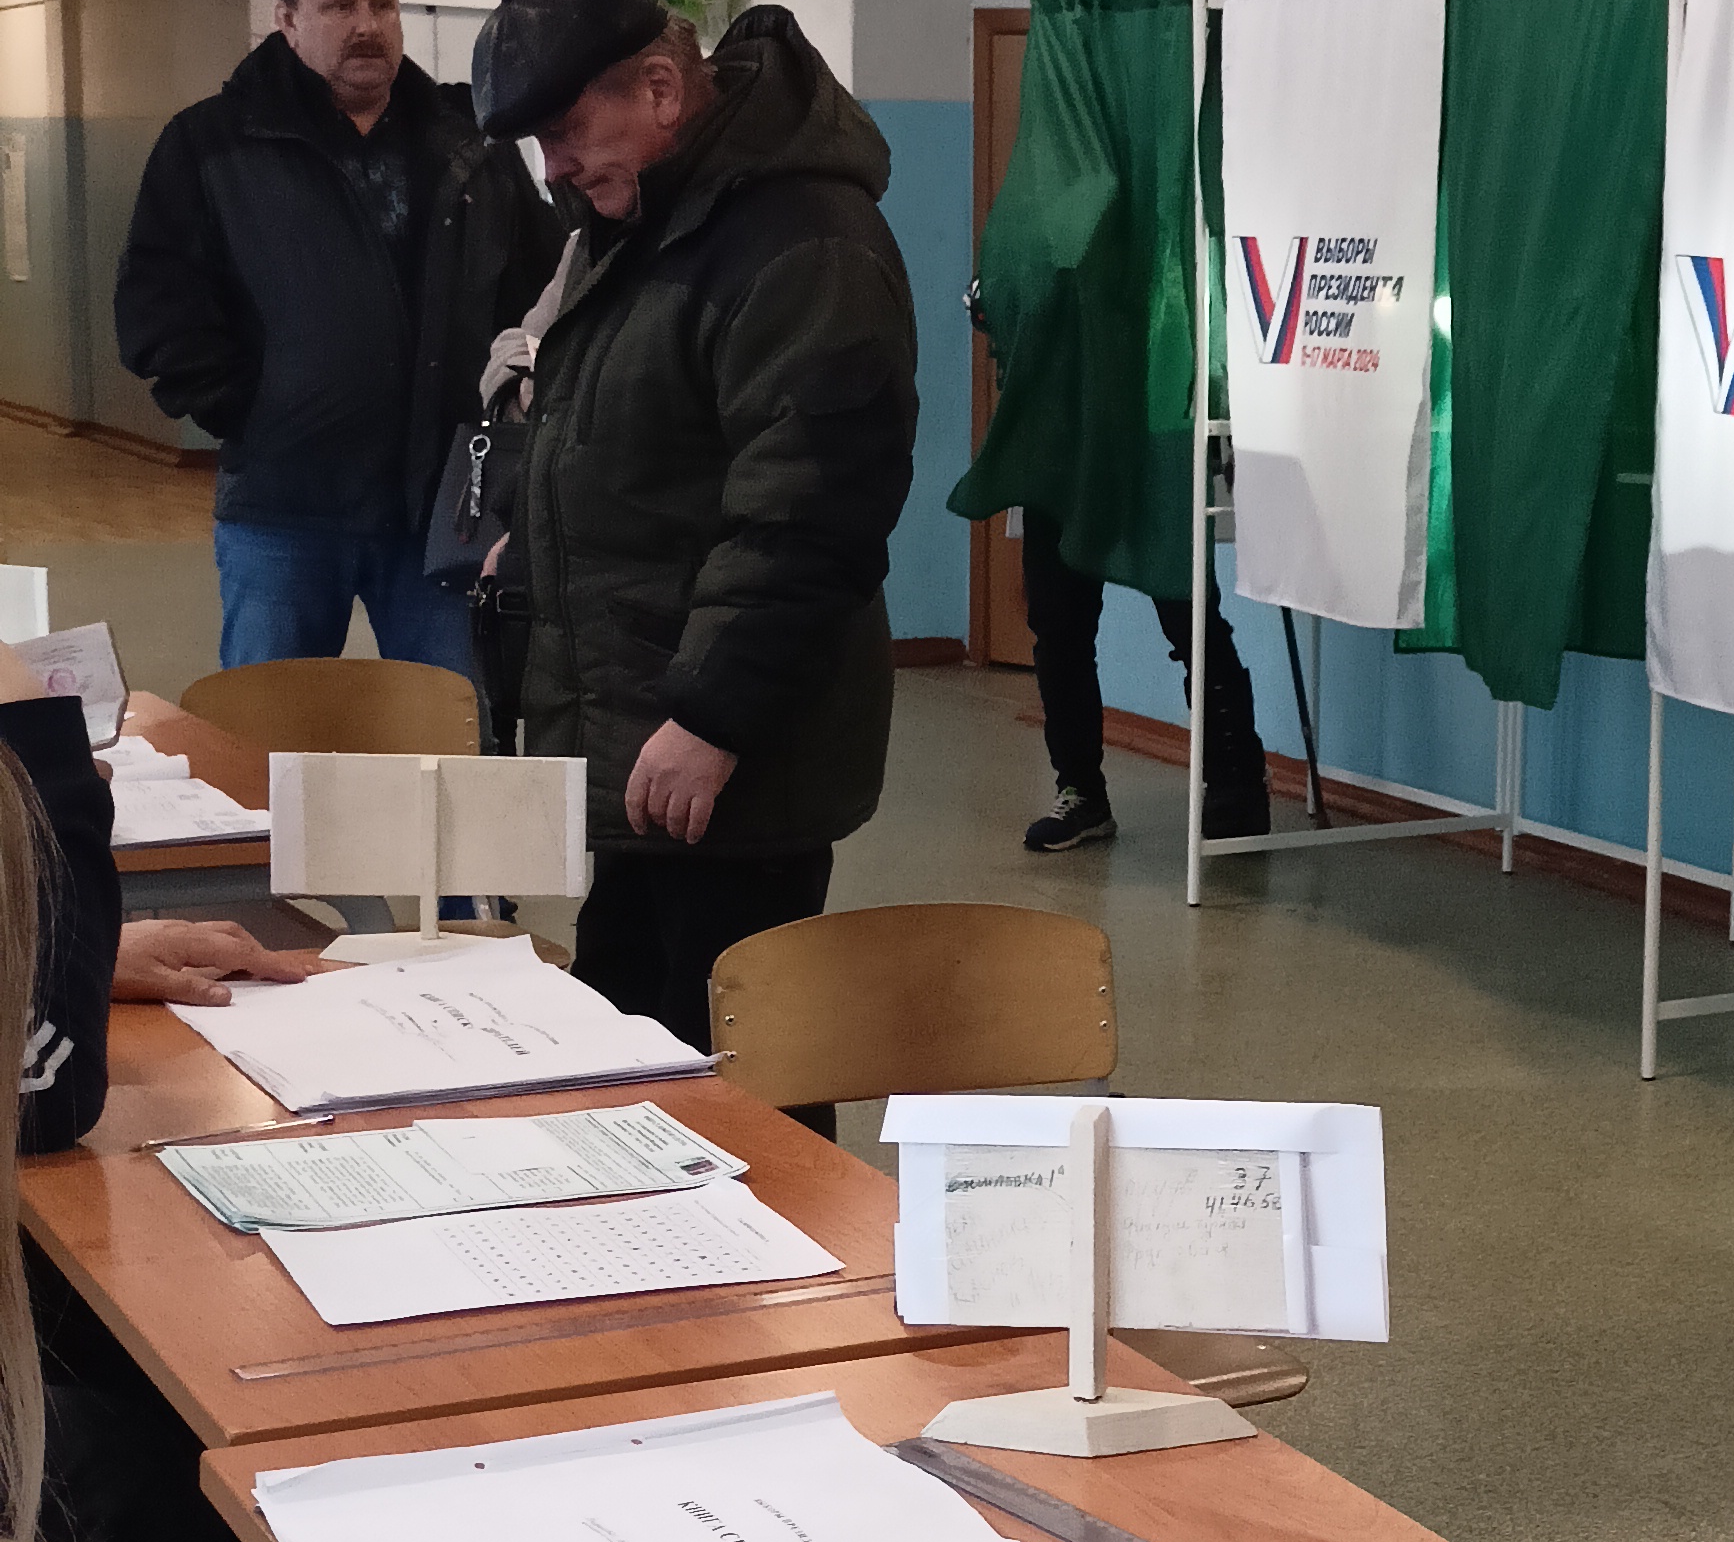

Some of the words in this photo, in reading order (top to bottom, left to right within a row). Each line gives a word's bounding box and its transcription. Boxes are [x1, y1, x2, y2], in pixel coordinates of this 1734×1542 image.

[1313, 237, 1379, 265] ВЫБОРЫ
[1302, 310, 1356, 339] РОССИИ
[677, 1499, 726, 1532] КНИГА
